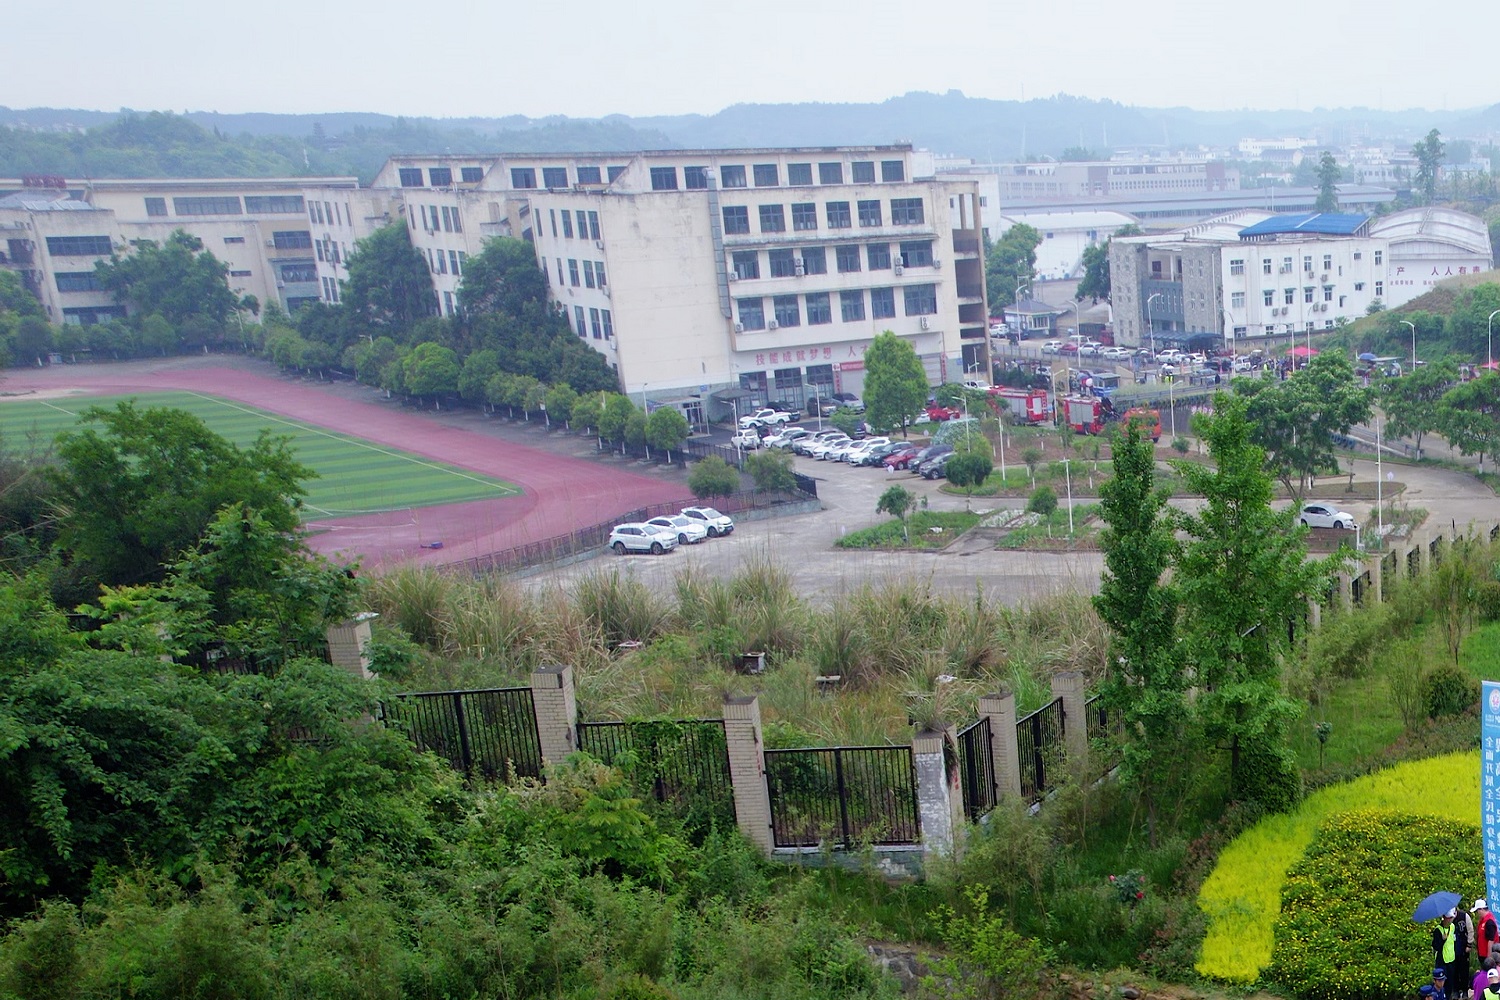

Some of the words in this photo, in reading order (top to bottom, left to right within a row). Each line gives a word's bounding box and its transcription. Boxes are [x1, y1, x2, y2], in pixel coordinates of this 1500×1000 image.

[756, 347, 832, 366] 技能成就梦想
